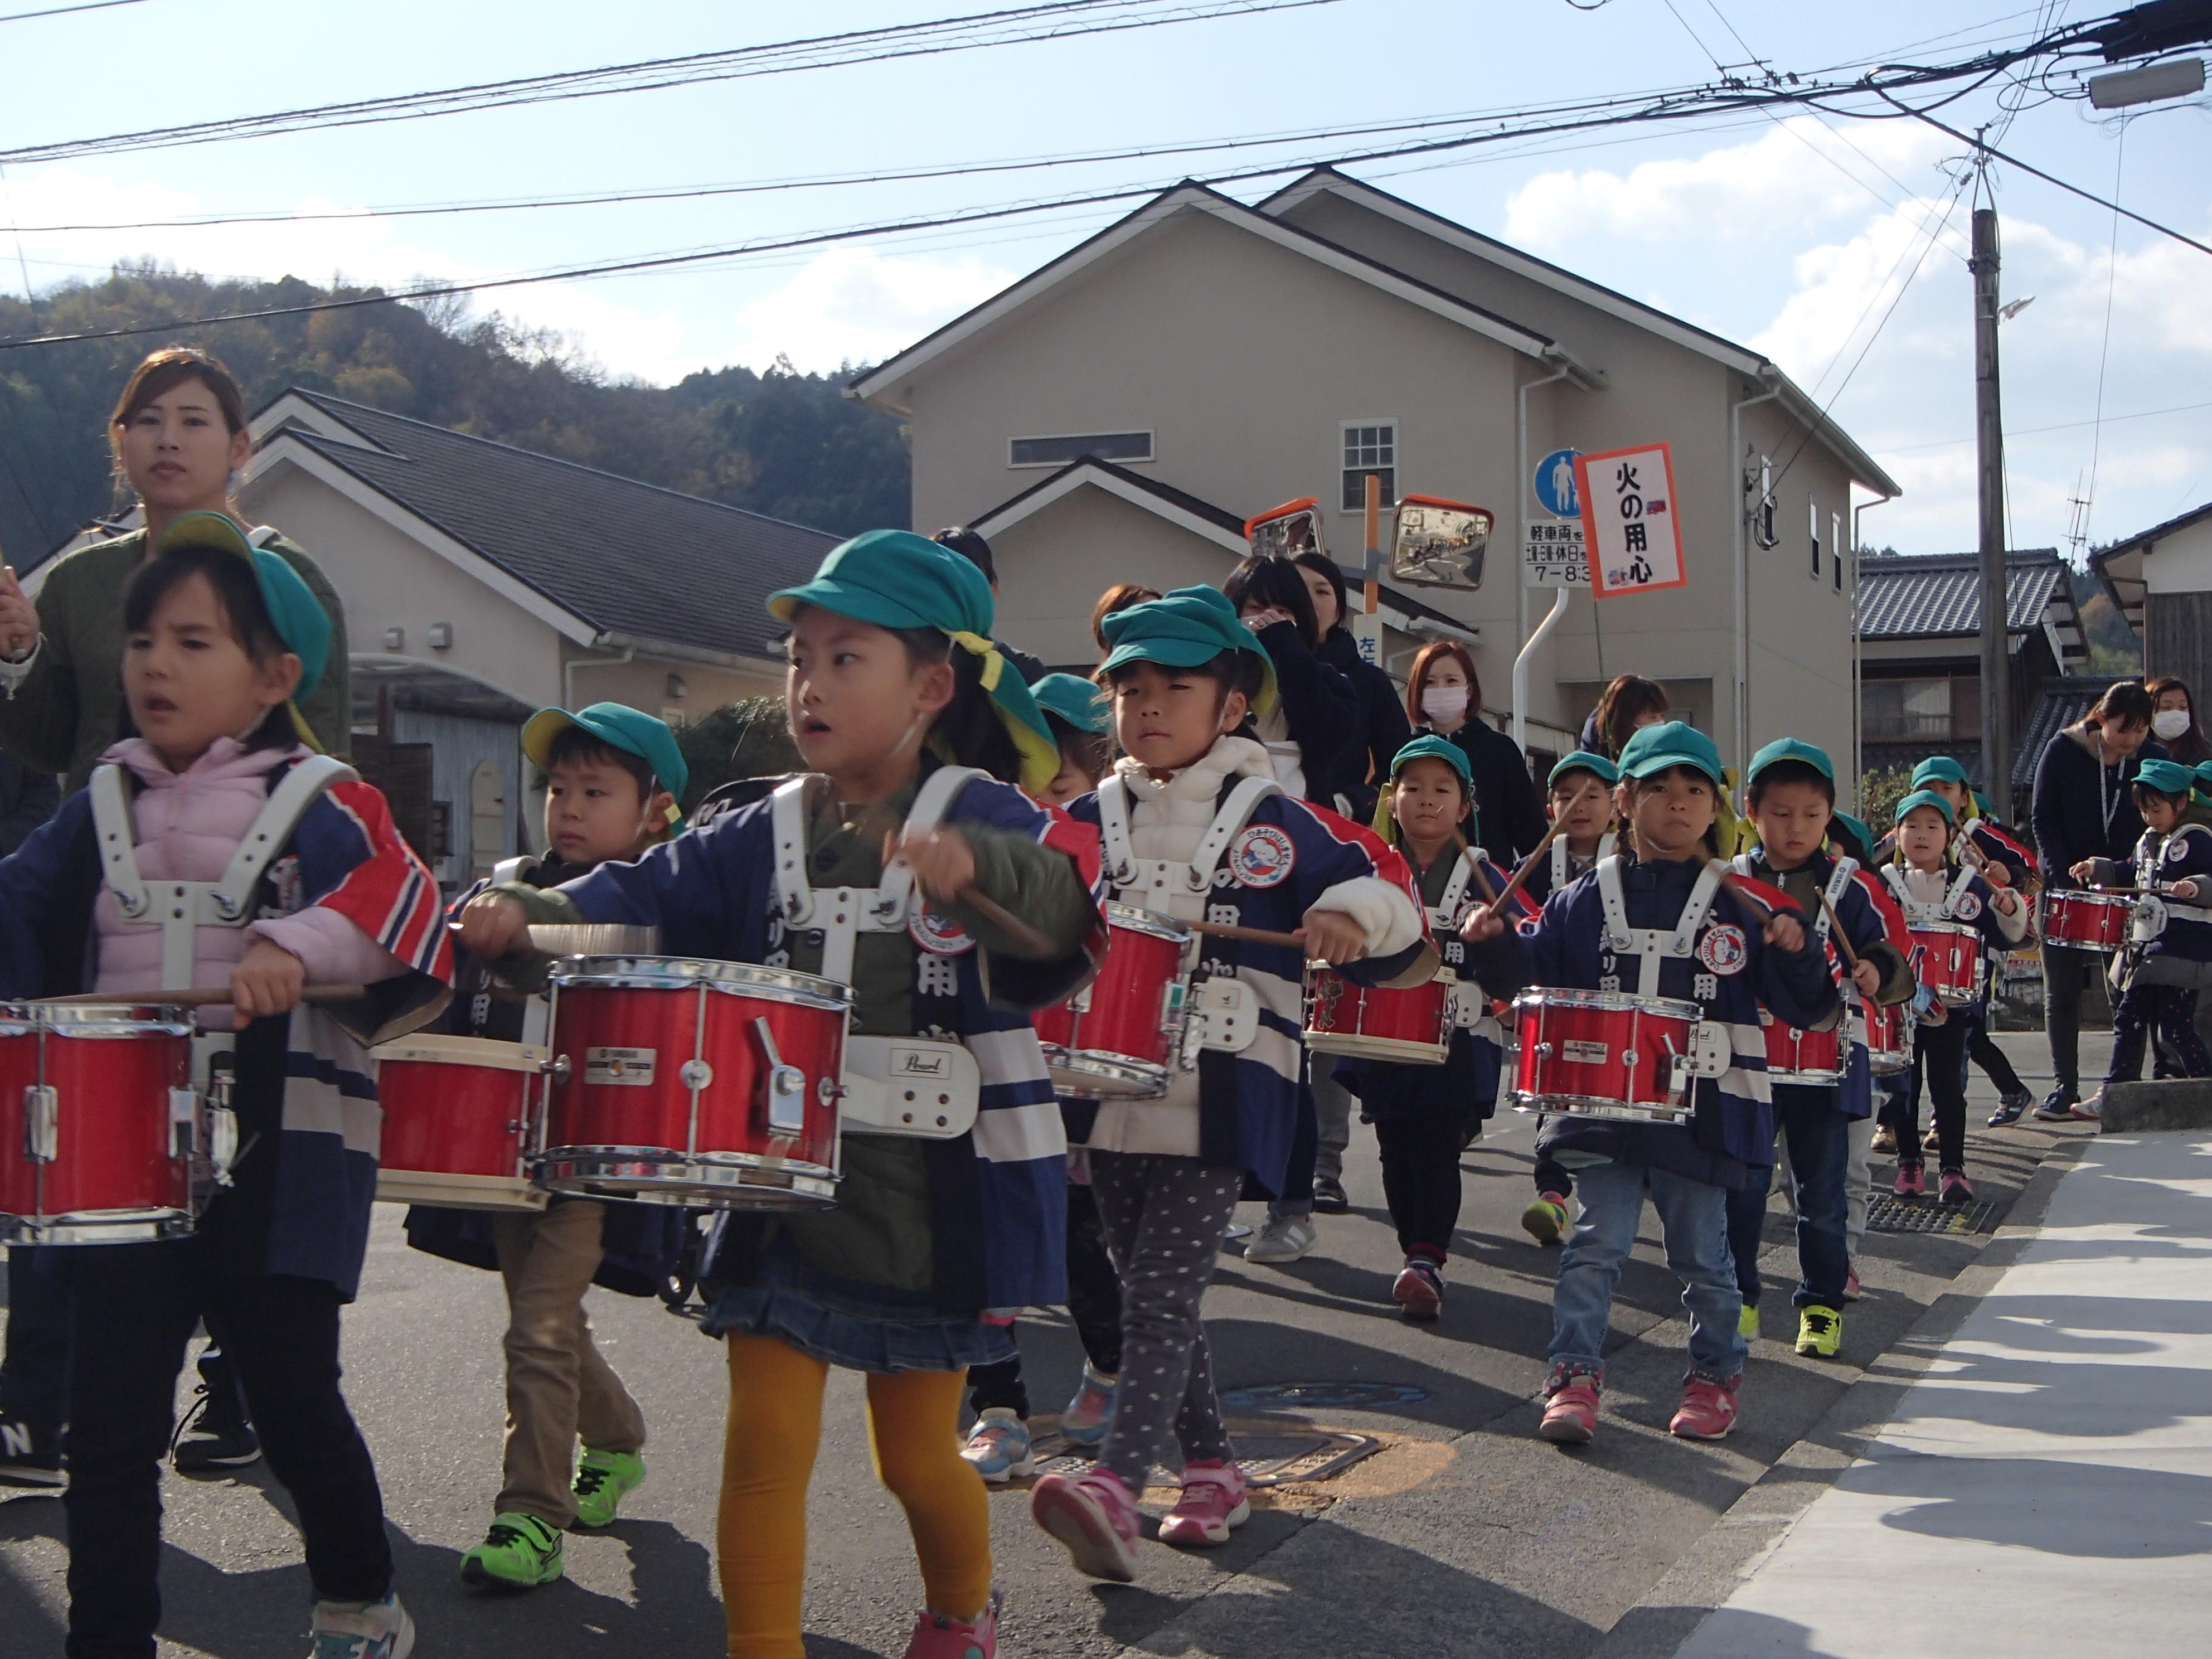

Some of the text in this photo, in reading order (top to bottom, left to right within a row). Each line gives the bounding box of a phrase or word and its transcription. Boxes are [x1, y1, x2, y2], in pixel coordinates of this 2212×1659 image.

[1530, 525, 1583, 541] 軽車両を
[1616, 463, 1653, 584] 火の用心
[1, 1422, 32, 1457] N
